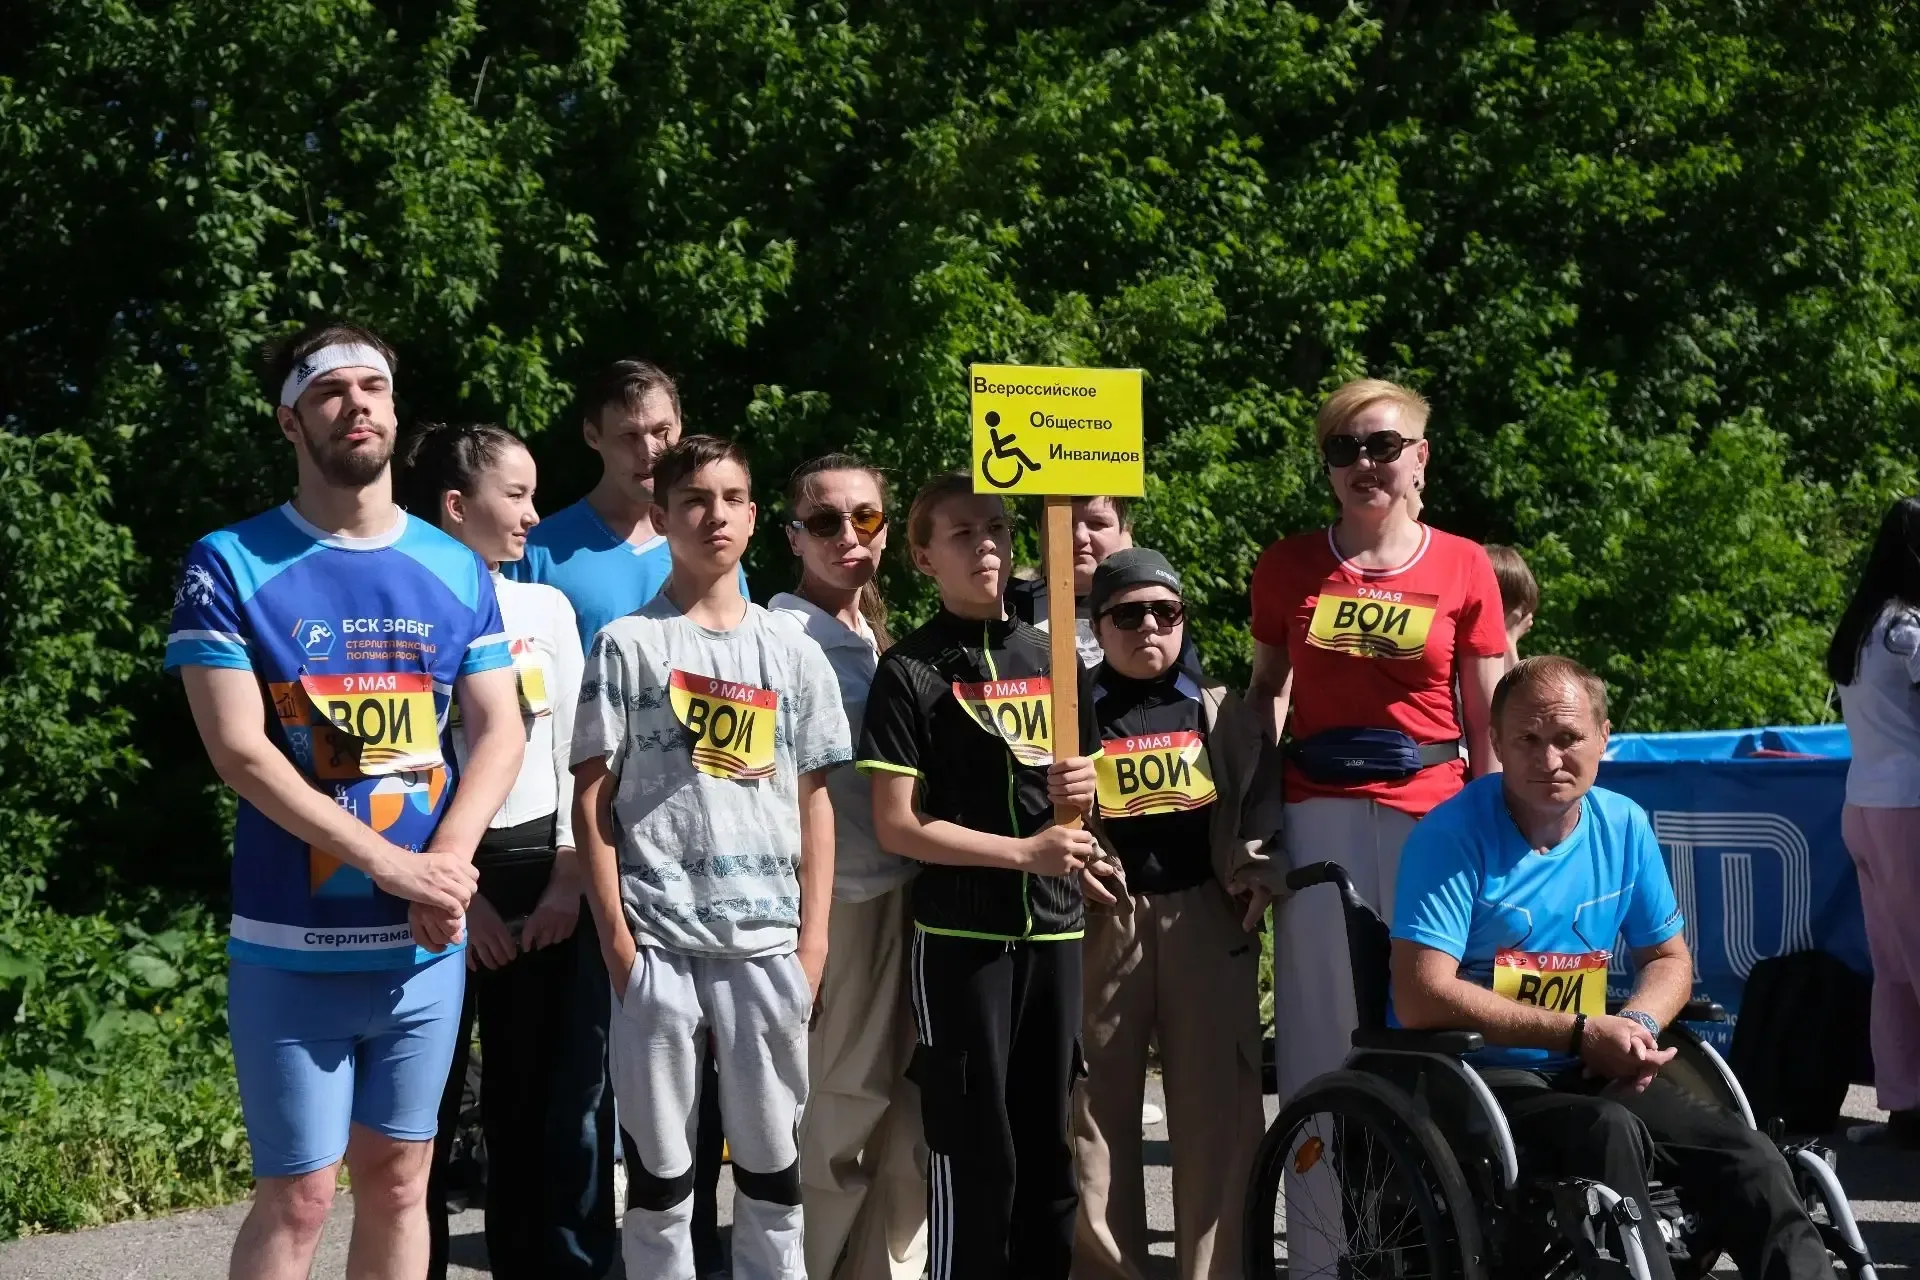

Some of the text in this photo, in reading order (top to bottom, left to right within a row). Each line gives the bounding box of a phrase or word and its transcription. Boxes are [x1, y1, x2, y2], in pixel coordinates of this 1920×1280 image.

[973, 376, 1097, 397] Всероссийское
[1029, 411, 1113, 430] Общество
[1049, 443, 1140, 463] Инвалидов
[1357, 587, 1403, 602] 9 МАЯ
[342, 619, 434, 637] БСК ЗАБЕГ
[1333, 601, 1412, 635] ВОИ
[343, 675, 397, 692] 9 МАЯ
[709, 681, 755, 703] 9 МАЯ
[983, 681, 1028, 697] 9 МАЯ
[328, 698, 413, 745] ВОИ
[685, 697, 756, 753] ВОИ
[975, 700, 1048, 742] ВОИ
[1126, 735, 1172, 752] 9 МАЯ
[1115, 752, 1191, 795] ВОИ
[304, 929, 413, 947] Стерлитама
[1537, 955, 1582, 970] 9 МАЯ
[1516, 973, 1584, 1014] ВОИ
